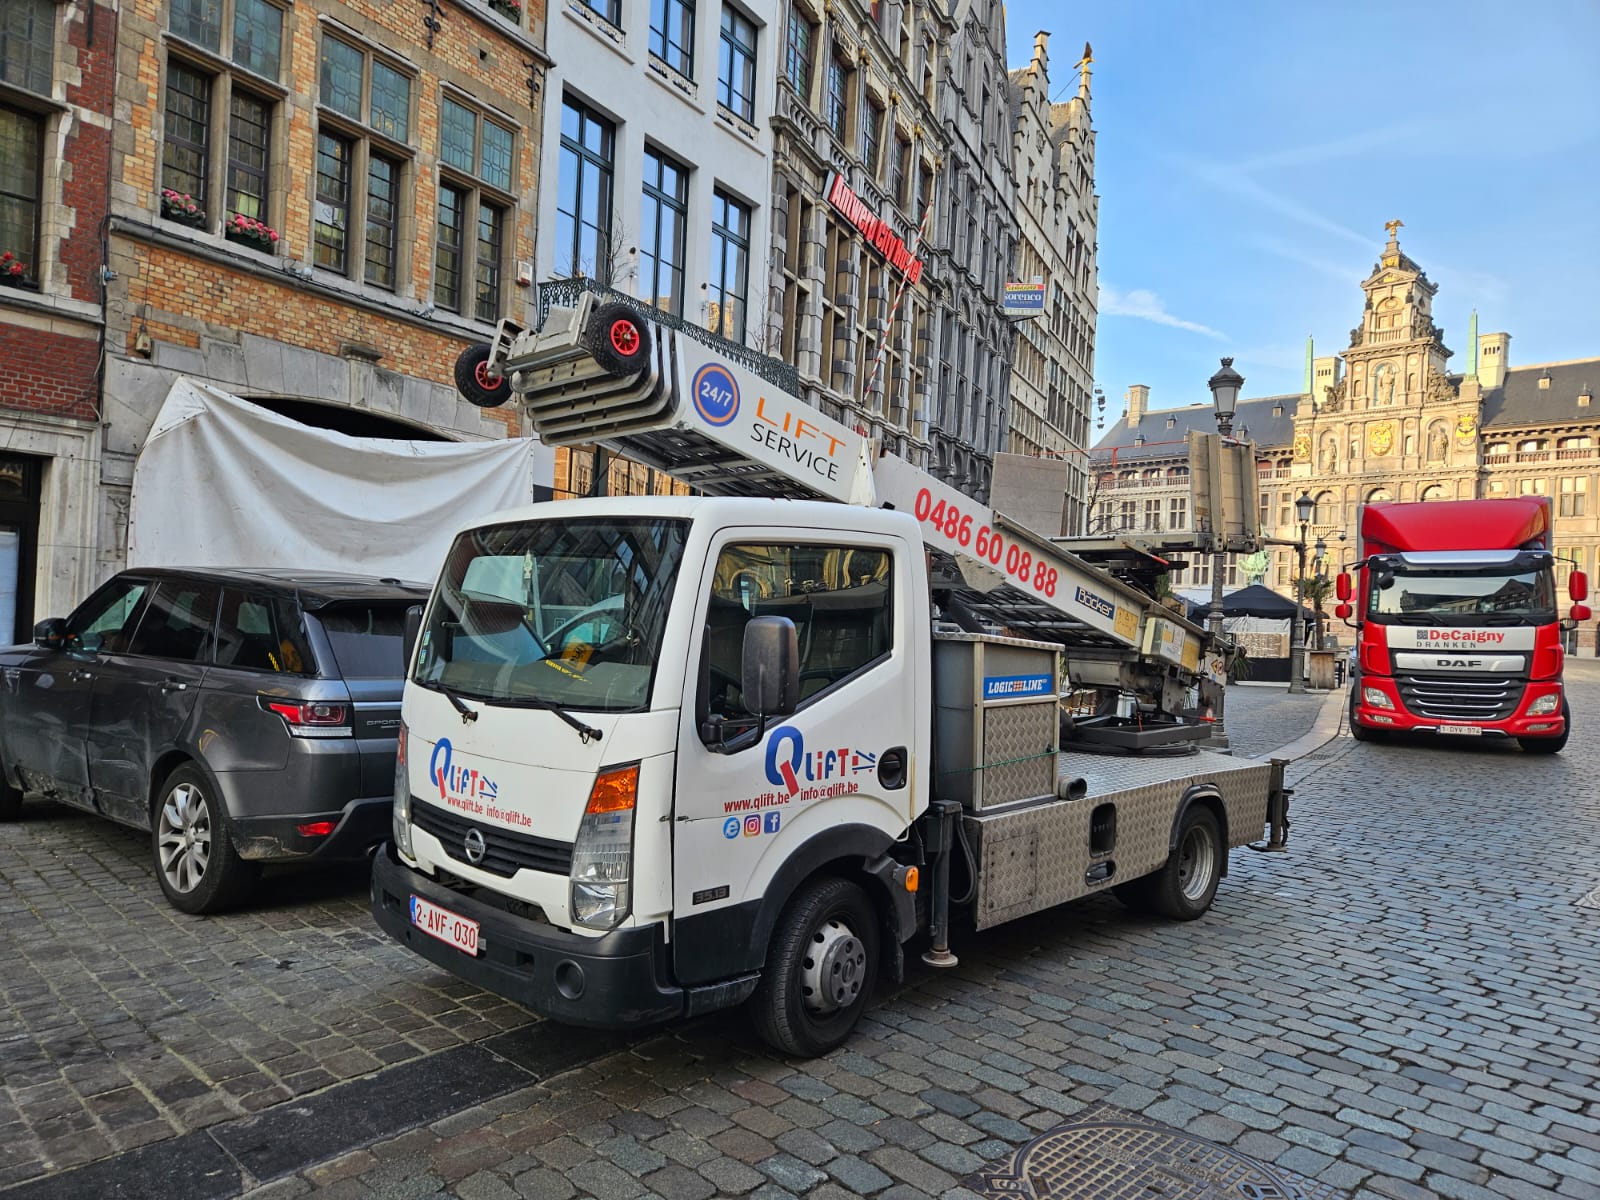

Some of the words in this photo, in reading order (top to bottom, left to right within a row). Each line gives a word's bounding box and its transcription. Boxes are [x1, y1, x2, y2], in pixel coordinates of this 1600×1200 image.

[829, 174, 879, 241] Antwerp
[875, 219, 897, 261] City
[701, 381, 733, 407] 24/7
[756, 397, 847, 457] LIFT
[750, 423, 839, 482] SERVICE
[914, 487, 973, 547] 0486
[975, 525, 1003, 565] 60
[1006, 543, 1032, 582] 08
[1033, 561, 1058, 598] 88
[1429, 630, 1504, 643] DeCaigny
[988, 681, 1014, 694] LOGIC
[1022, 680, 1043, 691] LINE
[447, 796, 483, 815] www.qlift.be
[486, 805, 532, 827] info@qlift.be
[724, 791, 790, 813] www.qlift.be
[800, 781, 859, 801] info@qlift.be
